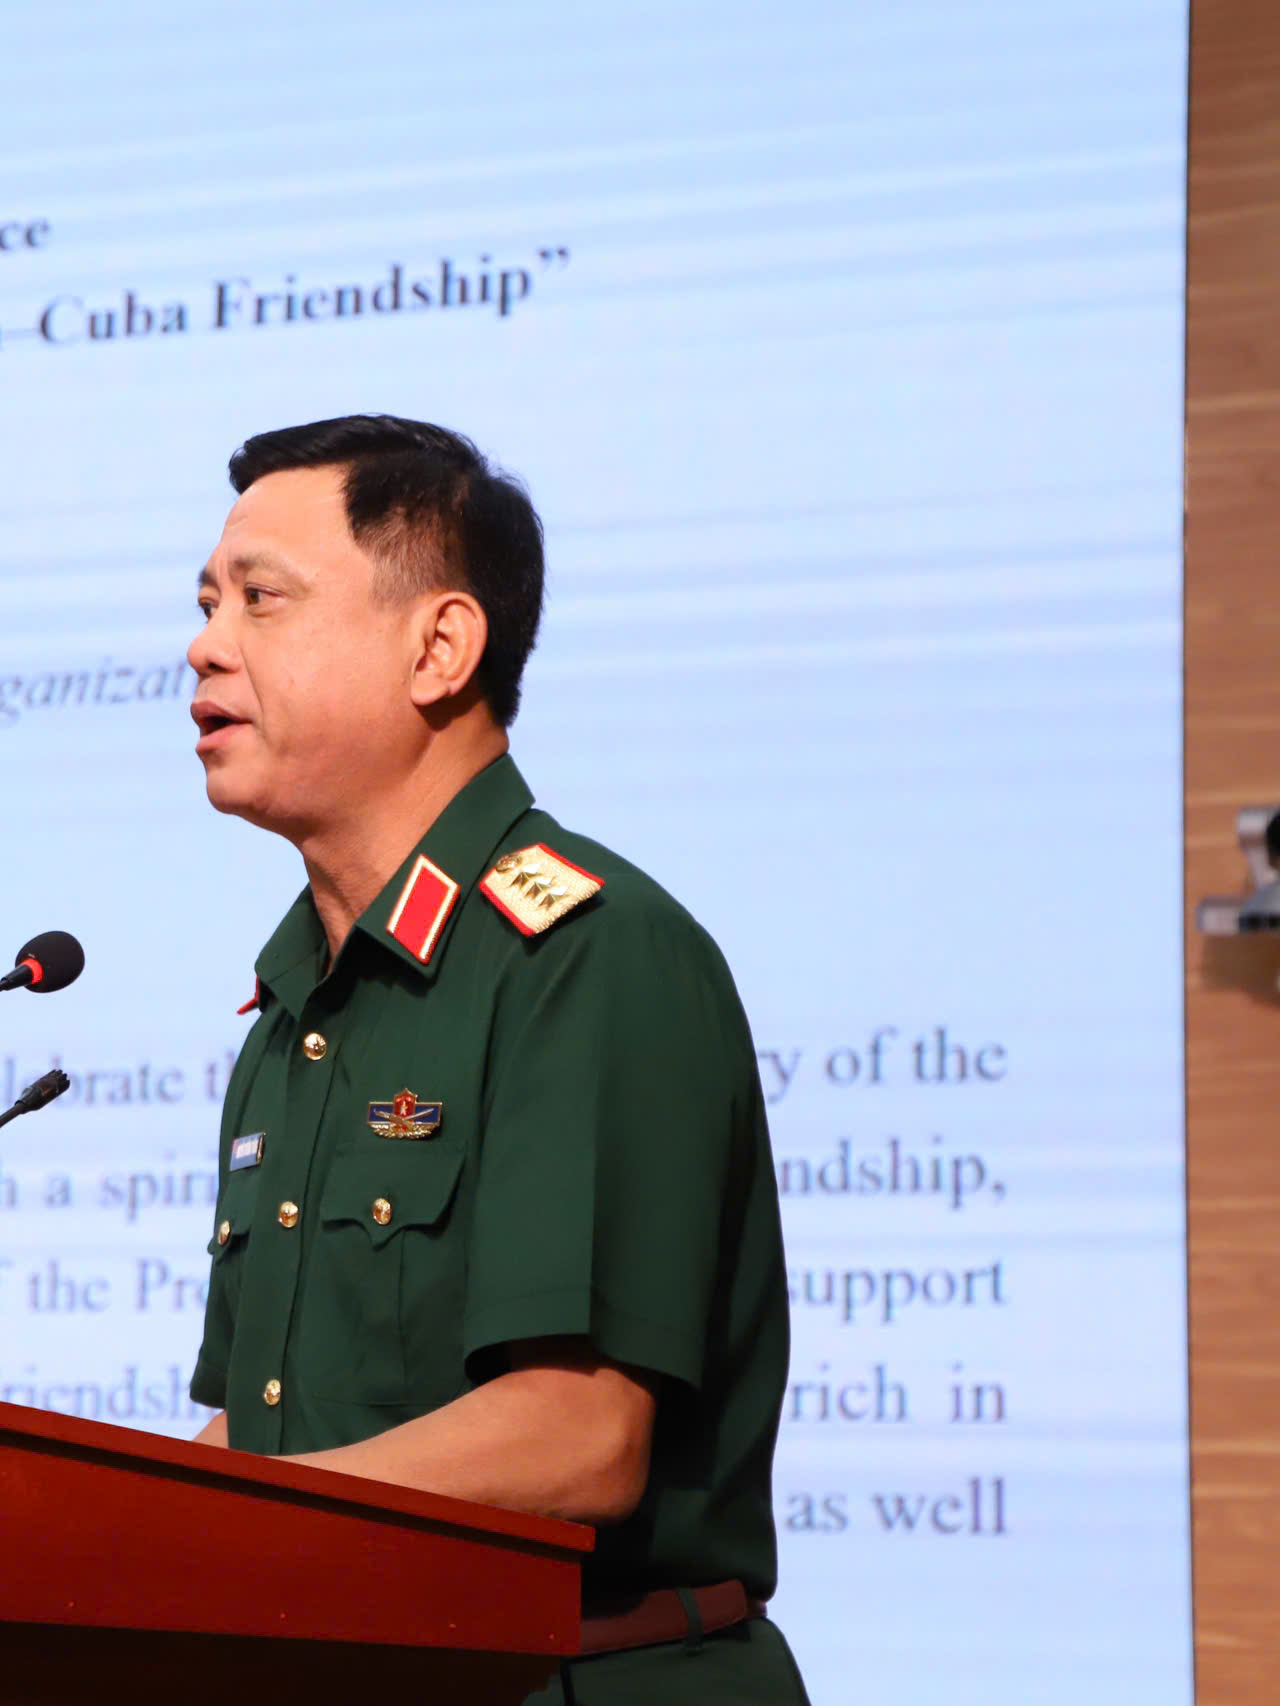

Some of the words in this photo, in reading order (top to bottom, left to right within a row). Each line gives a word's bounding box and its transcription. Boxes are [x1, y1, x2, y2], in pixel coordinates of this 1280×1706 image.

[825, 1026, 899, 1088] of
[910, 1026, 1008, 1086] the
[45, 1168, 72, 1208] a
[778, 1137, 1009, 1210] ndship,
[26, 1258, 111, 1314] the
[786, 1362, 908, 1425] rich
[948, 1362, 1008, 1425] in
[784, 1490, 848, 1536] as
[872, 1476, 1008, 1538] well
